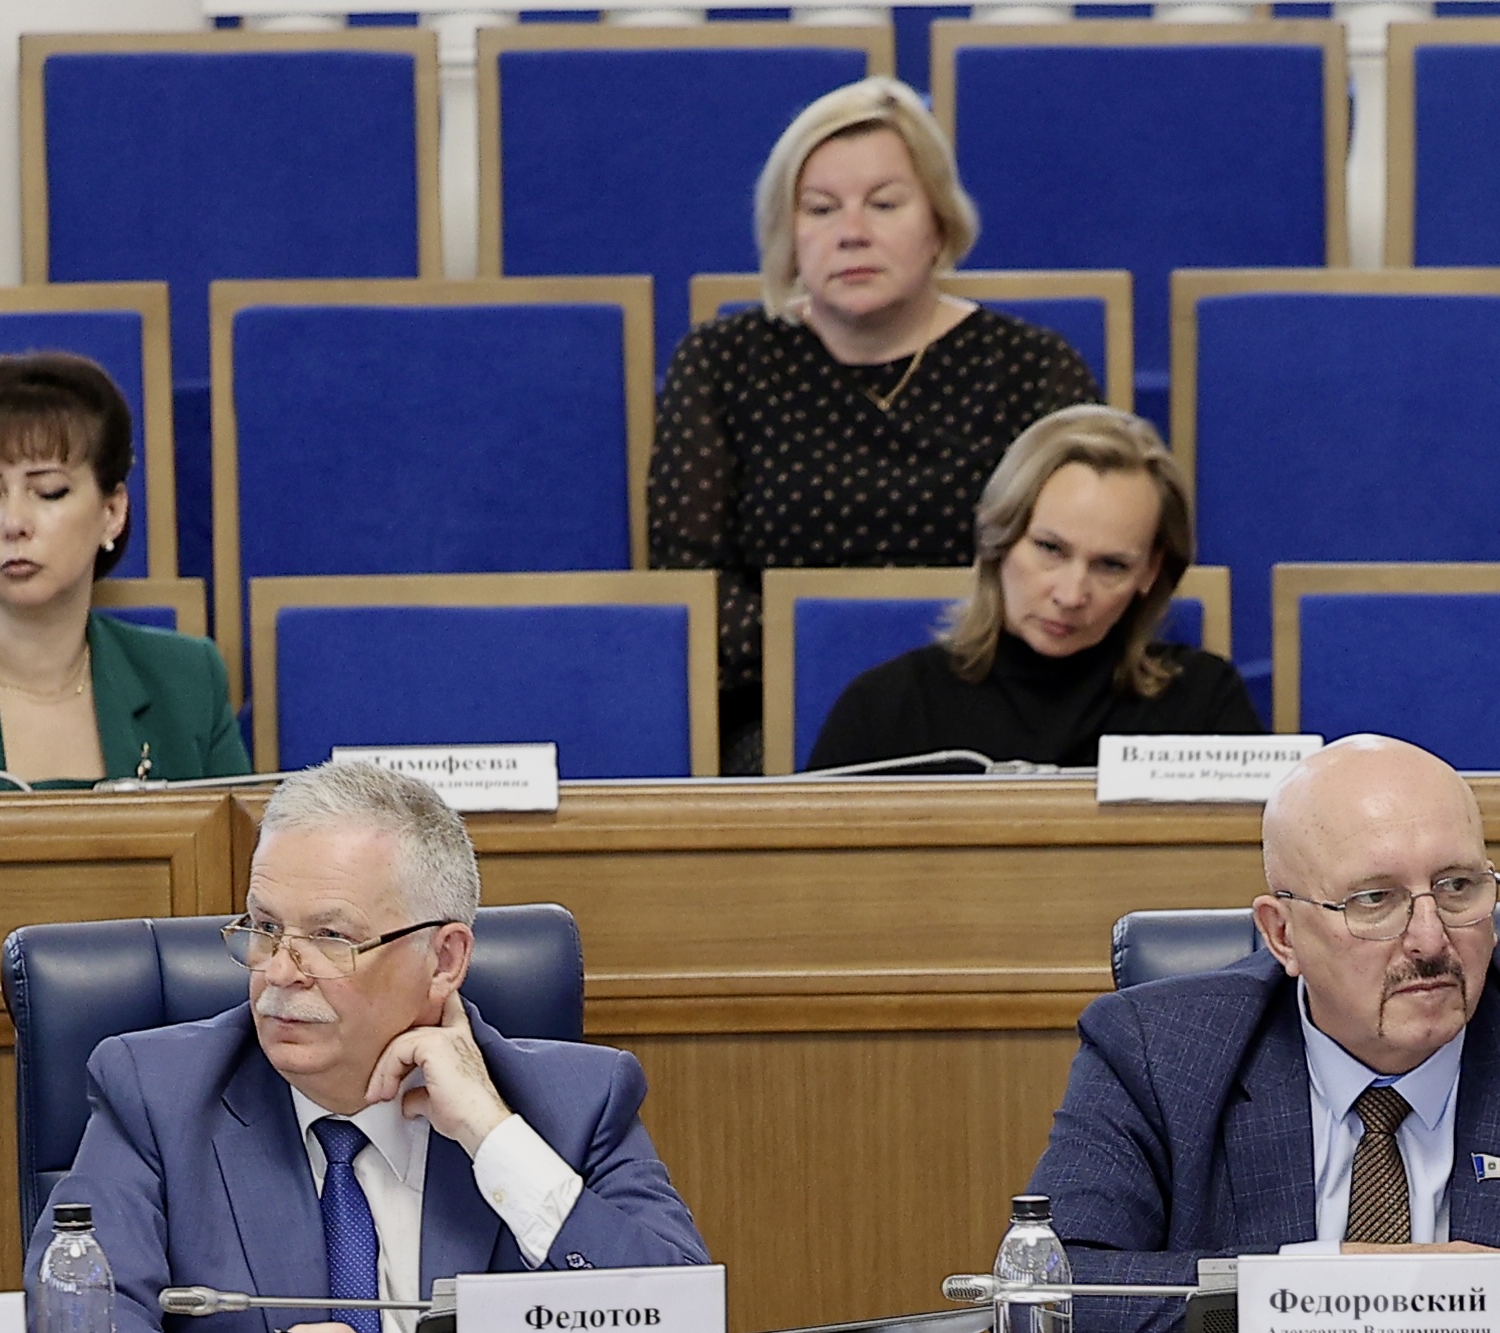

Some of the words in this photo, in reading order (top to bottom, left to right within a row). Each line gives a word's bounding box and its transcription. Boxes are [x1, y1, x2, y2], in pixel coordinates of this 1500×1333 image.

[1121, 746, 1302, 765] Владимирова
[1269, 1286, 1487, 1320] Федоровский
[524, 1305, 661, 1331] Федотов
